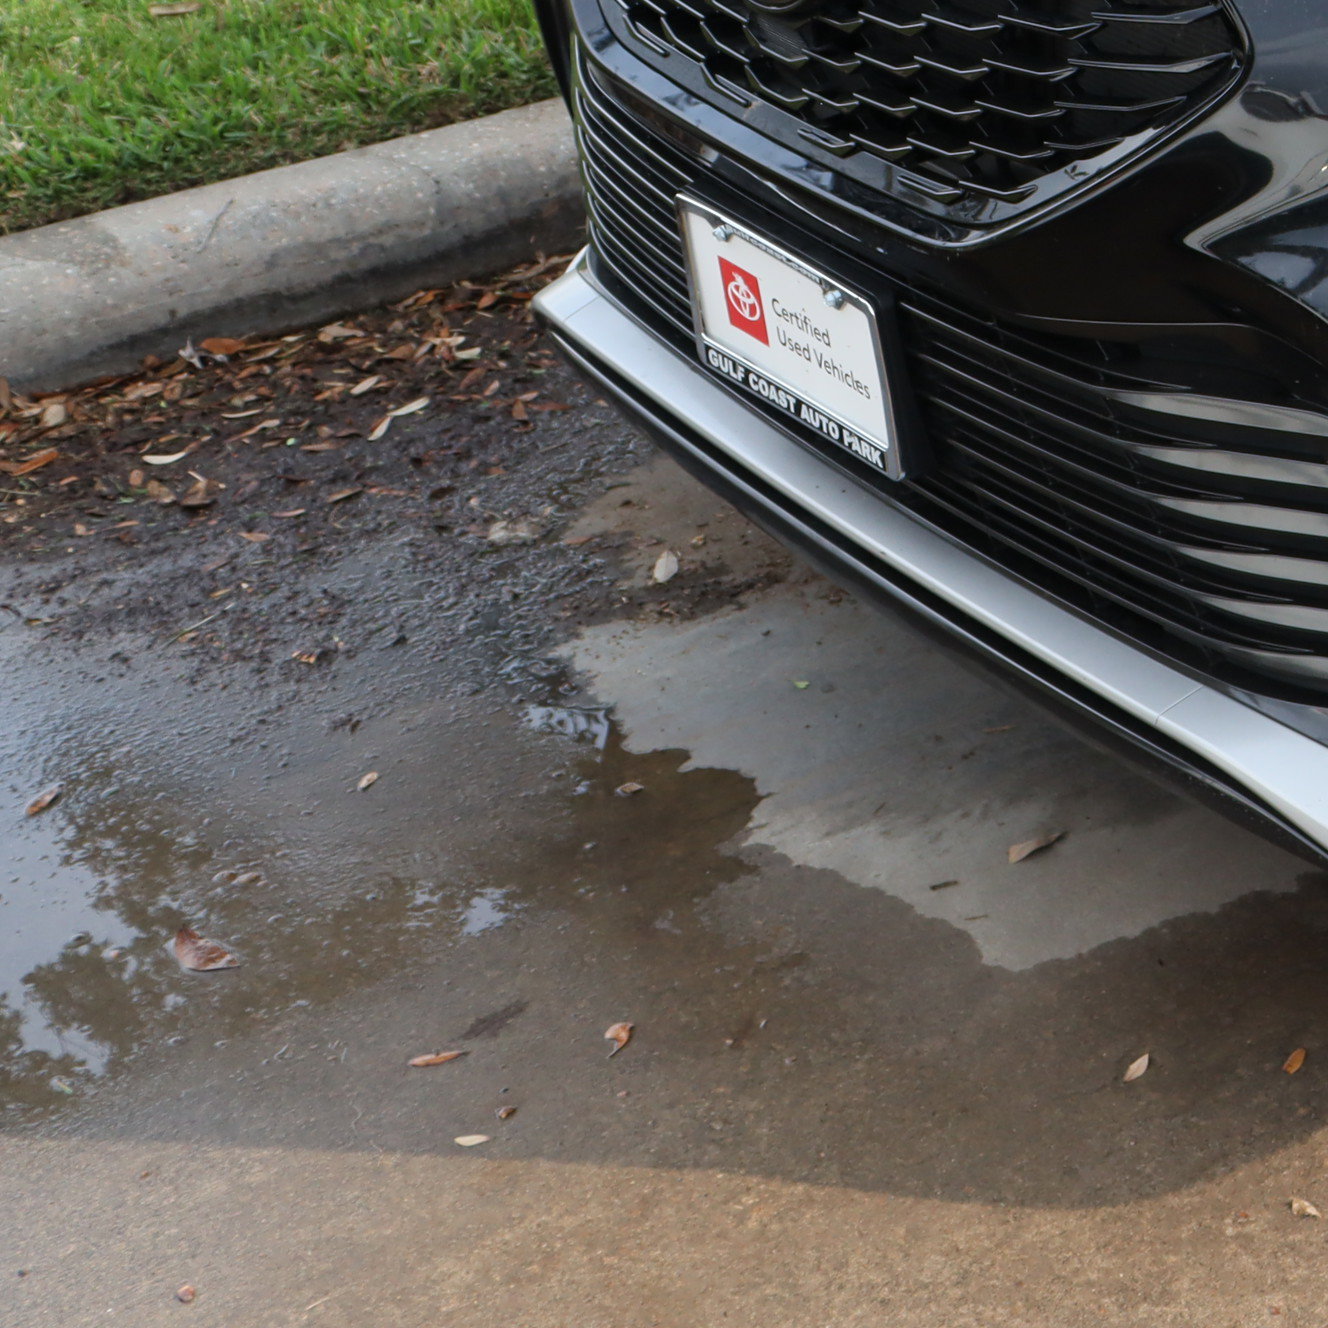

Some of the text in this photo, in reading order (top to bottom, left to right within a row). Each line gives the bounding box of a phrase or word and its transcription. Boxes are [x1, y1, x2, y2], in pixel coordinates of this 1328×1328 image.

[771, 298, 831, 347] Certified
[776, 329, 872, 401] Used Vehicles
[707, 348, 884, 469] GULF COAST AUTO PARK
